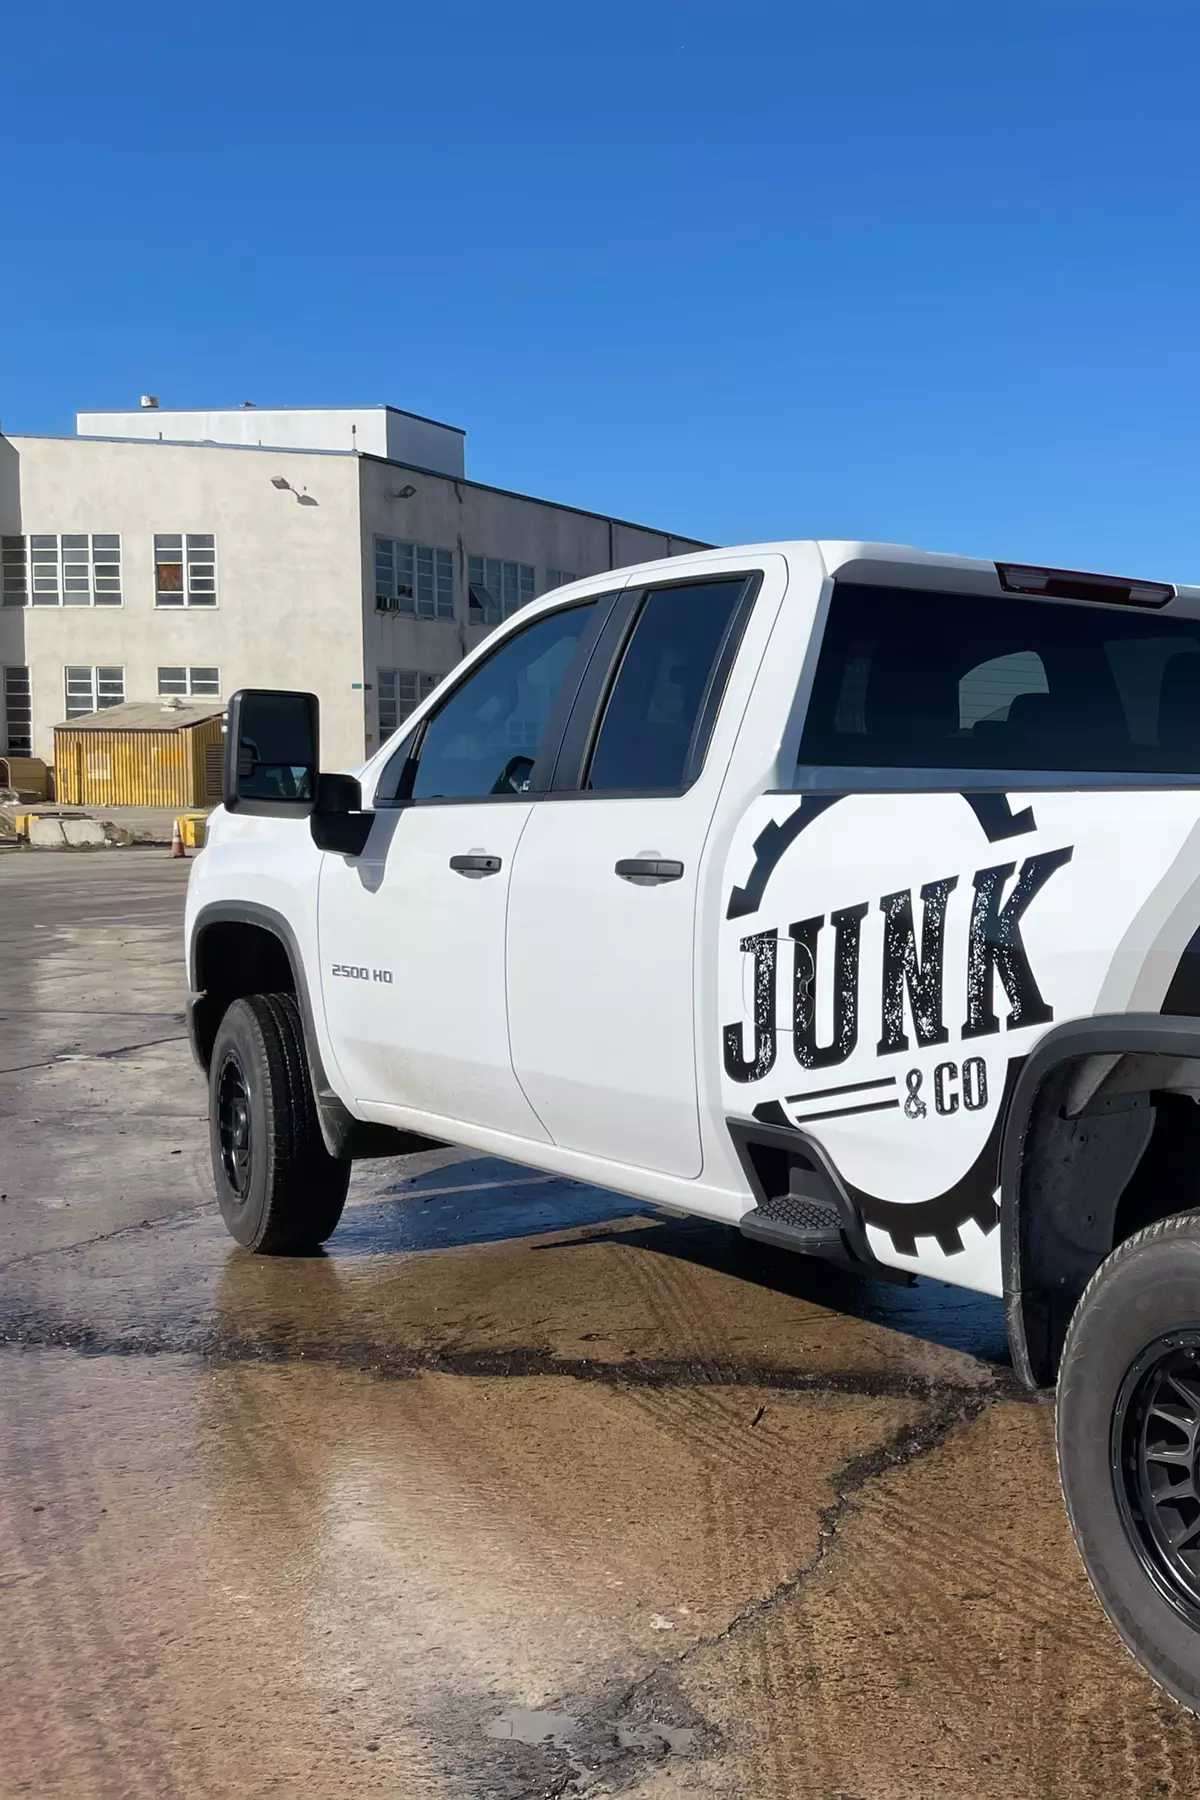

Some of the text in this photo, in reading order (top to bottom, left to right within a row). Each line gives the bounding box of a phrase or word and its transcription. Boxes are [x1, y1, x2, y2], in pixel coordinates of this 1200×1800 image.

[332, 964, 393, 984] 2500 HD
[724, 846, 1074, 1083] JUNK
